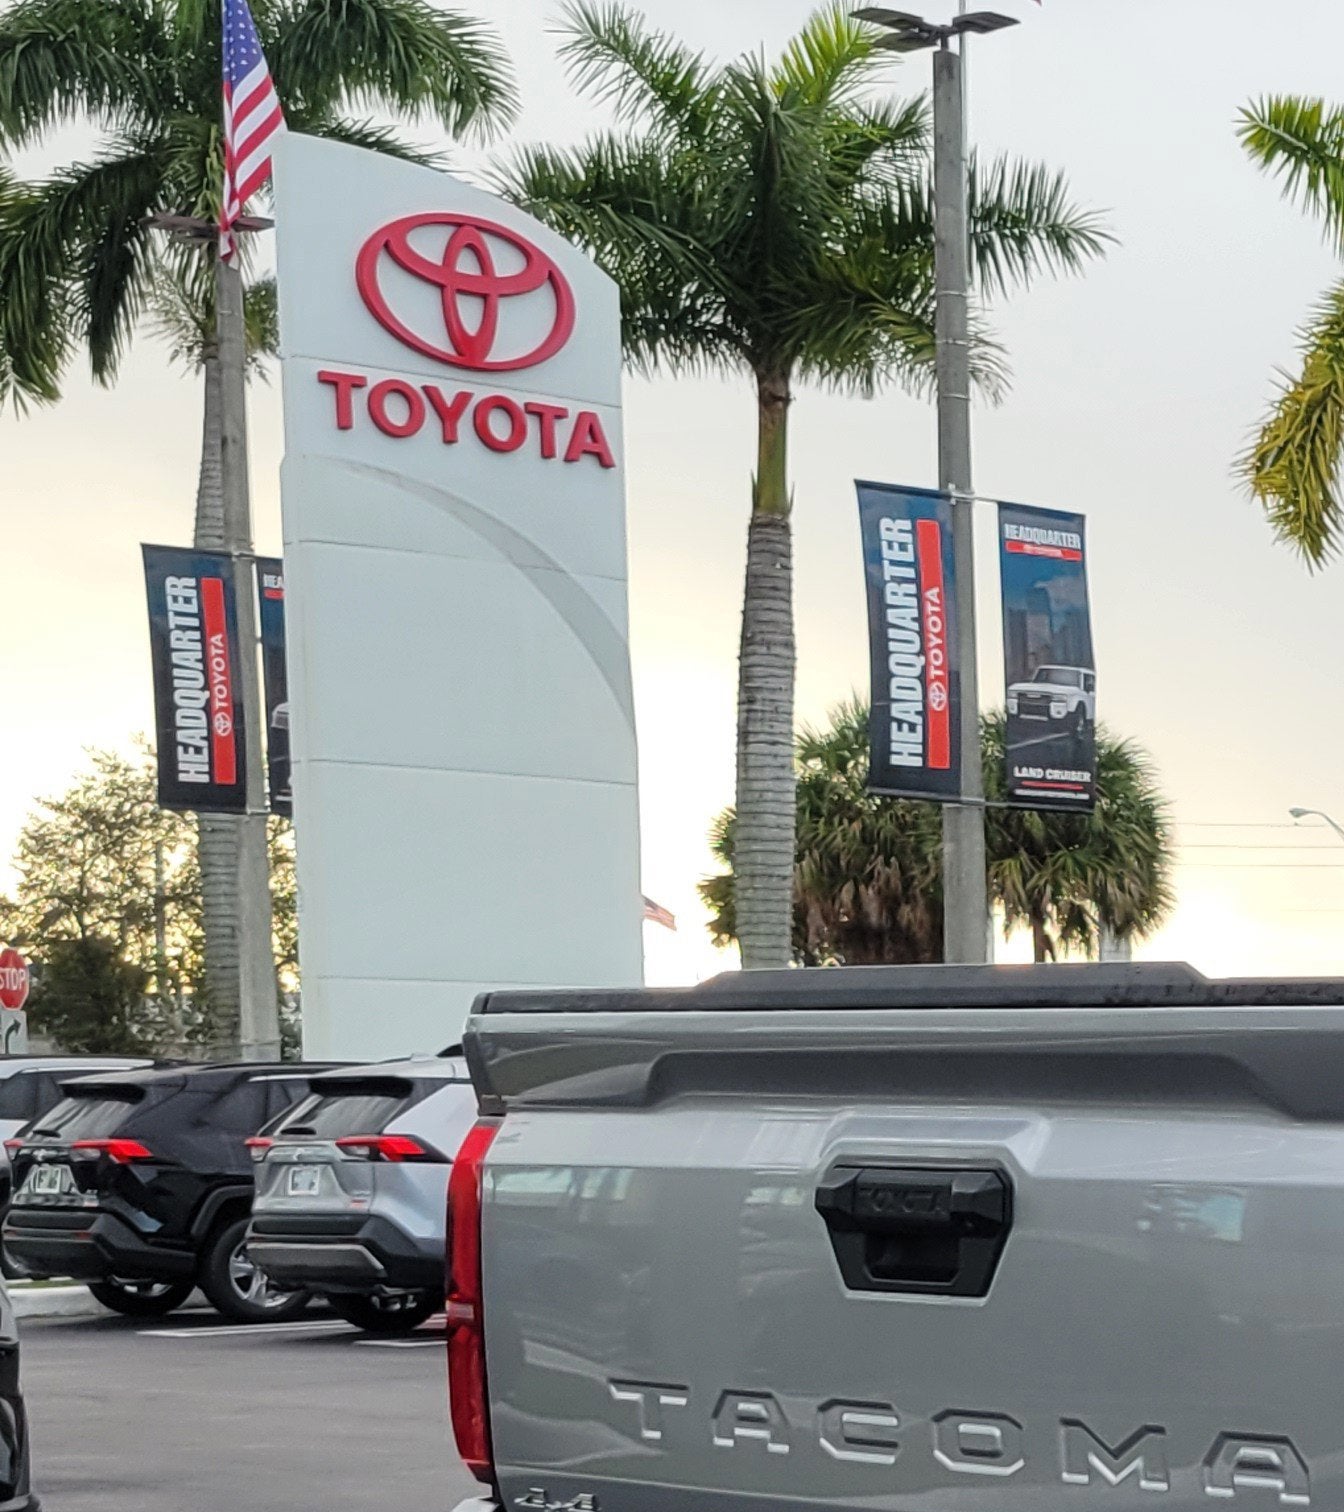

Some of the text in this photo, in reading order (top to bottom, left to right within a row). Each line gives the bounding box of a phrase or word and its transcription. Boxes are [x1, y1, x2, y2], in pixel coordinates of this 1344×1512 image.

[317, 370, 616, 468] TOYOTA
[1004, 523, 1081, 550] HEADQUARTER
[165, 574, 211, 784] HEADQUARTER
[210, 632, 229, 710] TOYOTA
[879, 516, 926, 767] HEADQUARTER
[923, 586, 944, 680] TOYOTA
[605, 1377, 1314, 1505] TACOMA
